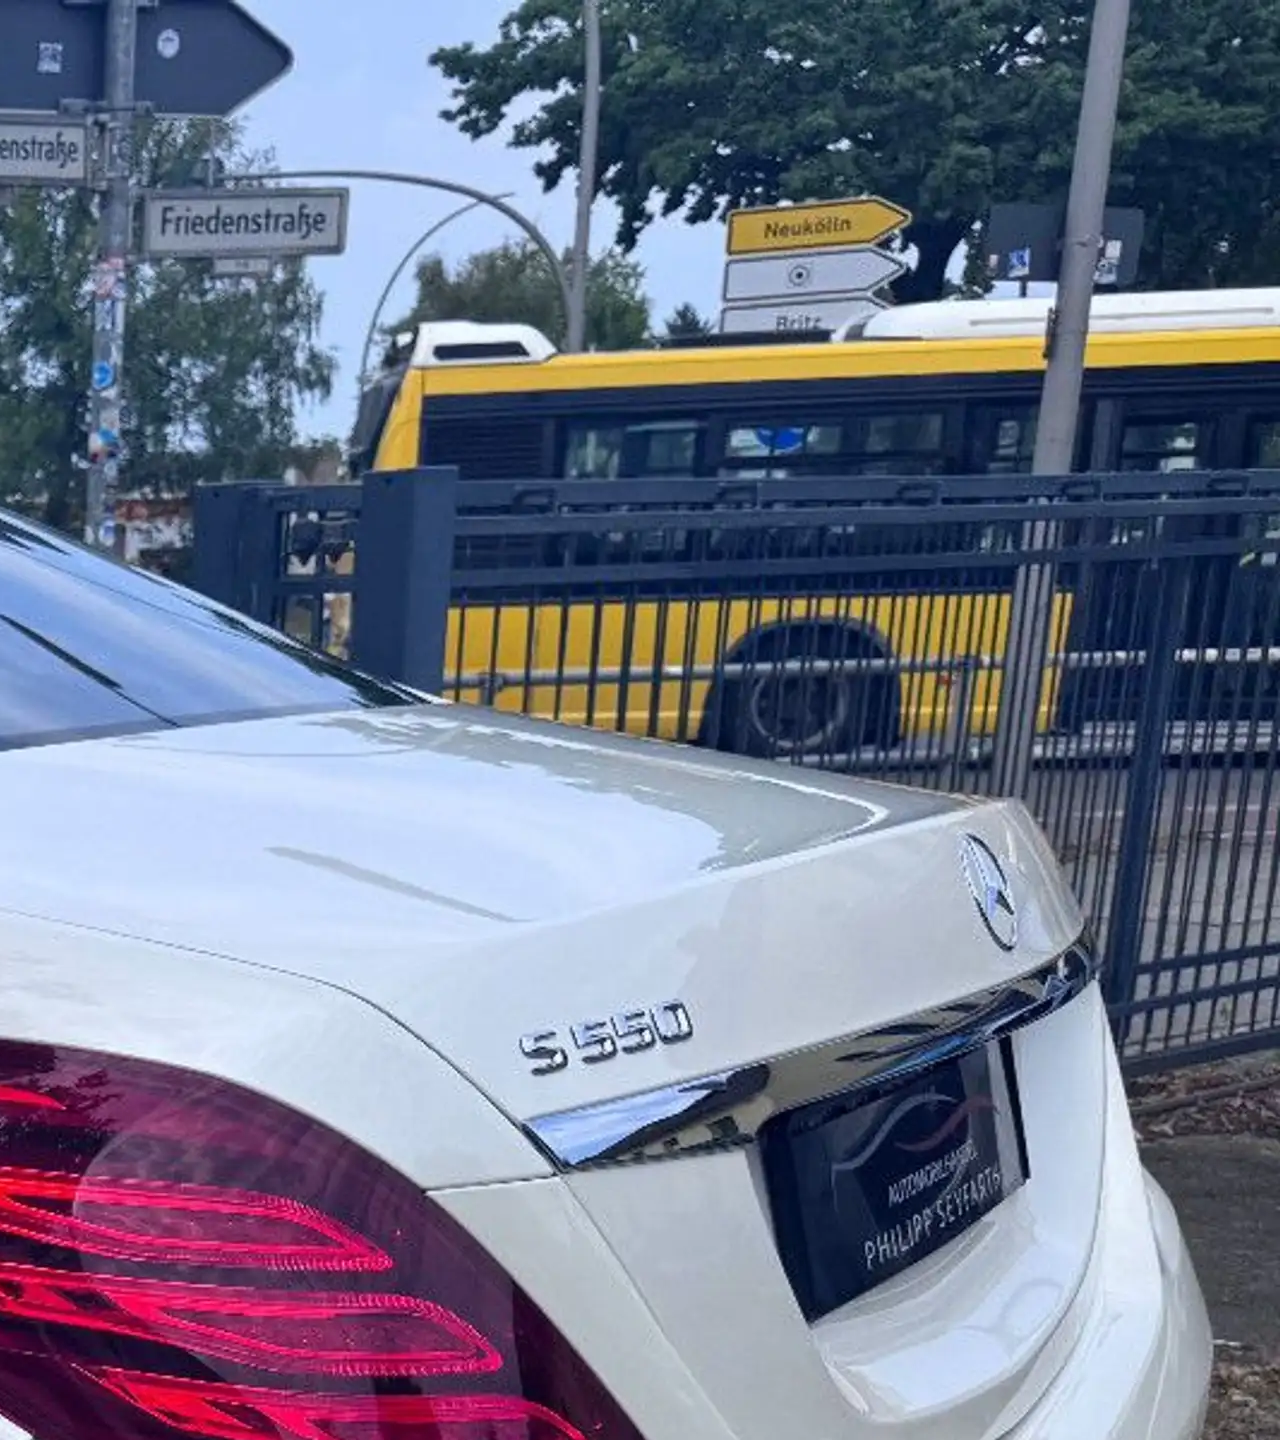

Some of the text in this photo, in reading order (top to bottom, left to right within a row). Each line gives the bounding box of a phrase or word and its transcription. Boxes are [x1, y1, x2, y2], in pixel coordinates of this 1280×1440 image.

[160, 203, 327, 240] Friedenstraße
[763, 217, 853, 240] Neukölln
[519, 1000, 694, 1076] S 550
[864, 1206, 934, 1271] PHILIPP
